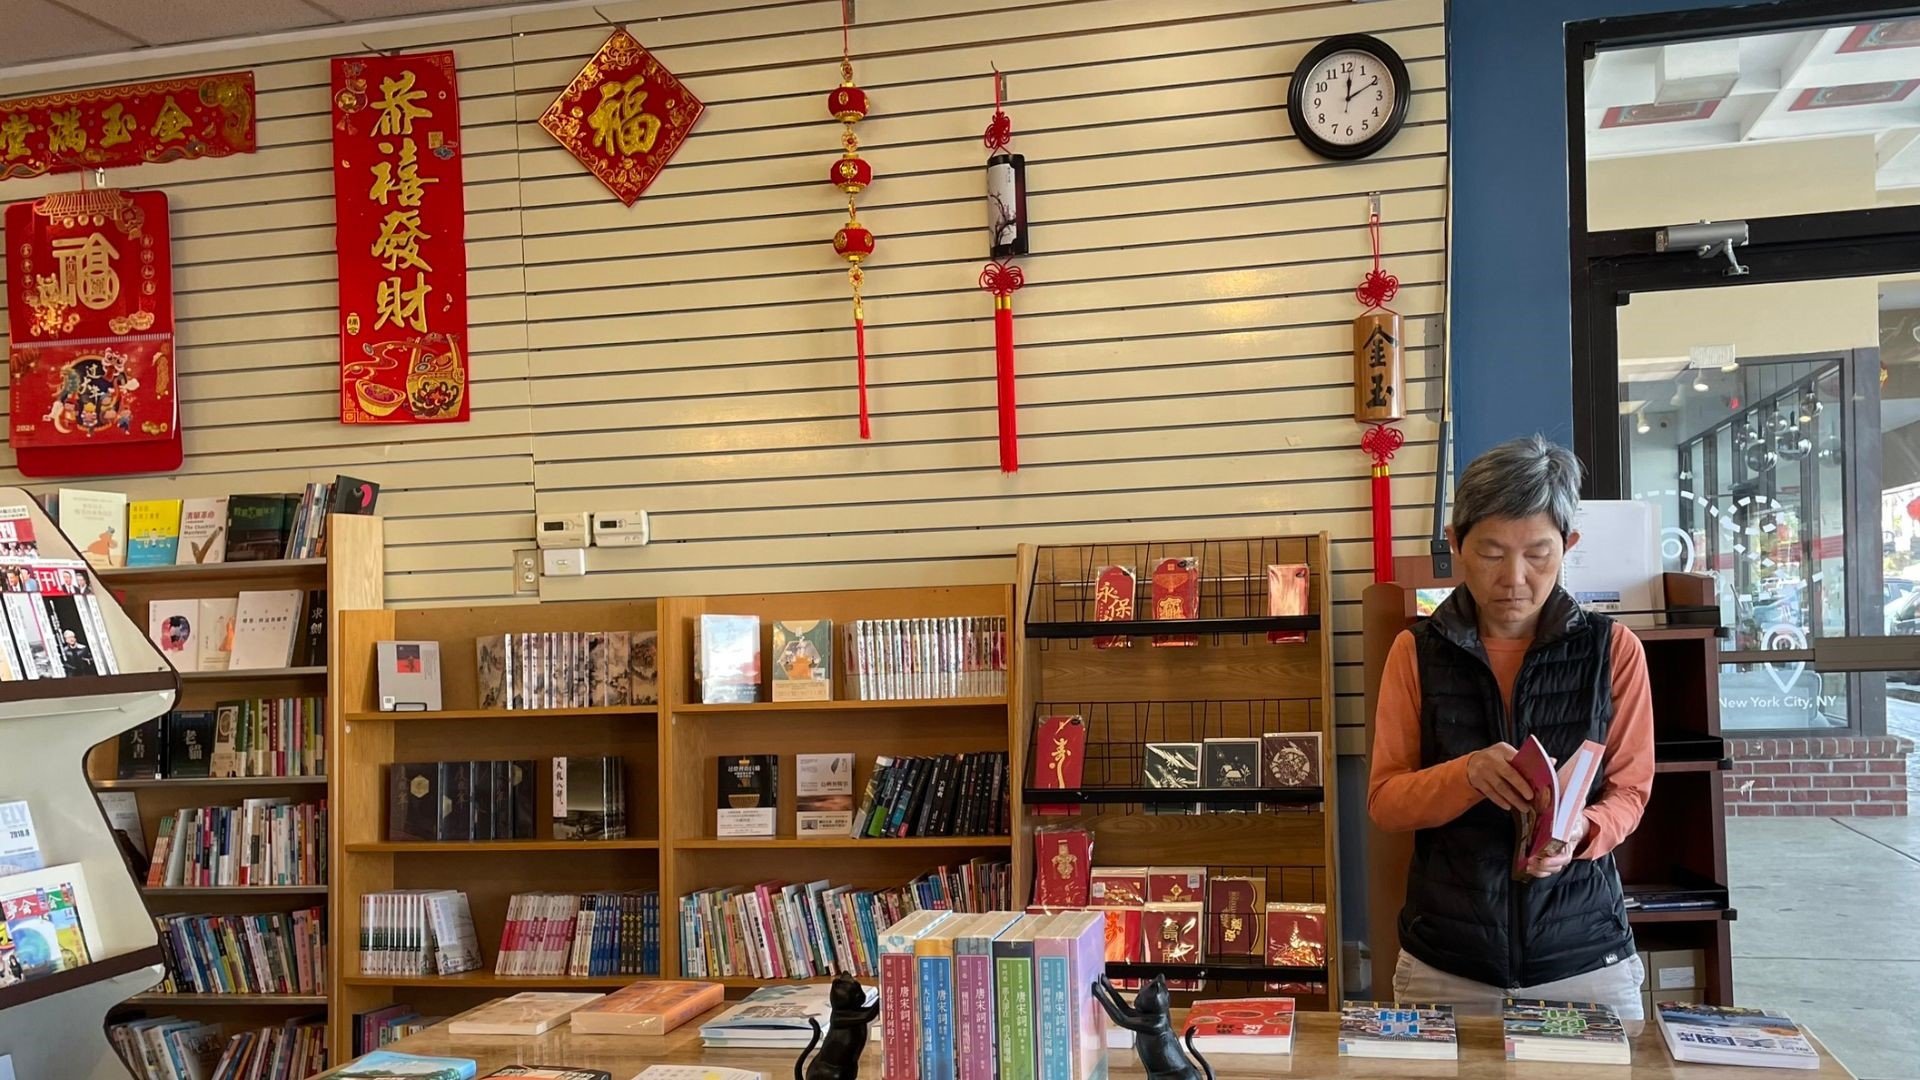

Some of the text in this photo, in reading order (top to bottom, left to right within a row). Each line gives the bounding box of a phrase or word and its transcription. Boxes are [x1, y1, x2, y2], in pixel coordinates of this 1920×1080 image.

[1341, 62, 1353, 74] 12
[1360, 65, 1366, 76] 1
[1326, 69, 1338, 80] 11
[1371, 75, 1378, 86] 2
[1316, 82, 1328, 93] 10
[1376, 90, 1383, 101] 3
[1314, 98, 1321, 109] 9
[588, 75, 661, 156] 福
[1371, 107, 1379, 117] 4
[1318, 113, 1326, 124] 8
[1331, 124, 1338, 135] 7
[1346, 125, 1353, 136] 6
[1362, 120, 1369, 131] 5
[369, 70, 439, 334] 恭禧發財
[1363, 324, 1398, 408] 金玉
[16, 424, 36, 433] 2024
[1750, 696, 1780, 709] York
[1783, 695, 1813, 710] City,
[1816, 695, 1837, 707] NY
